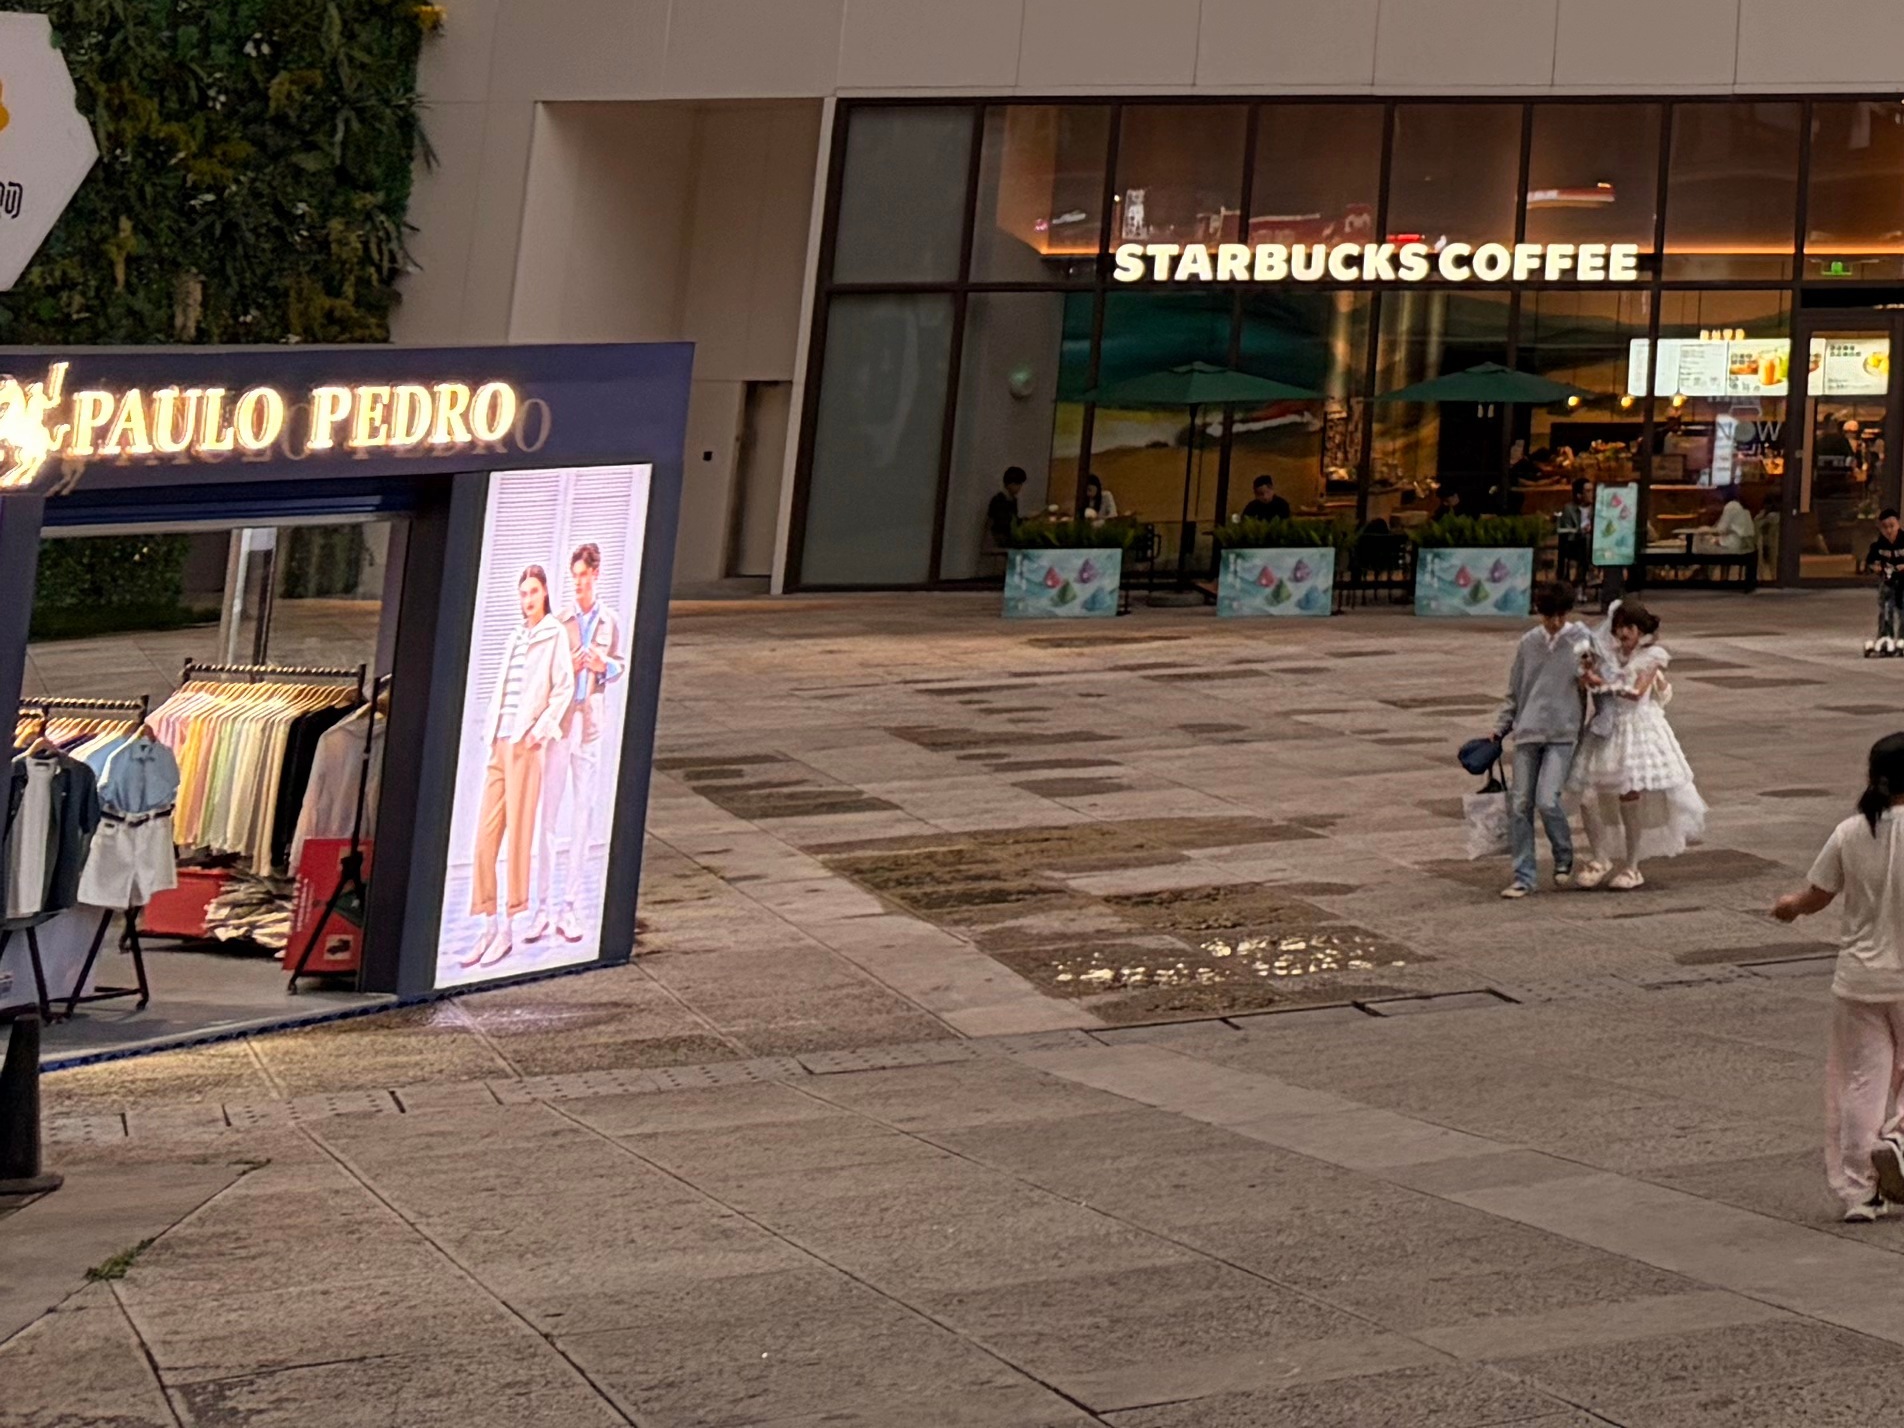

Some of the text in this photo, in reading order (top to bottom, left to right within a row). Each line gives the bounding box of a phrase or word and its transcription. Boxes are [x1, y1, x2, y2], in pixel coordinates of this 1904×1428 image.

[1113, 242, 1639, 283] STARBUCKS COFFEE
[73, 381, 518, 455] PAULO PEDRO
